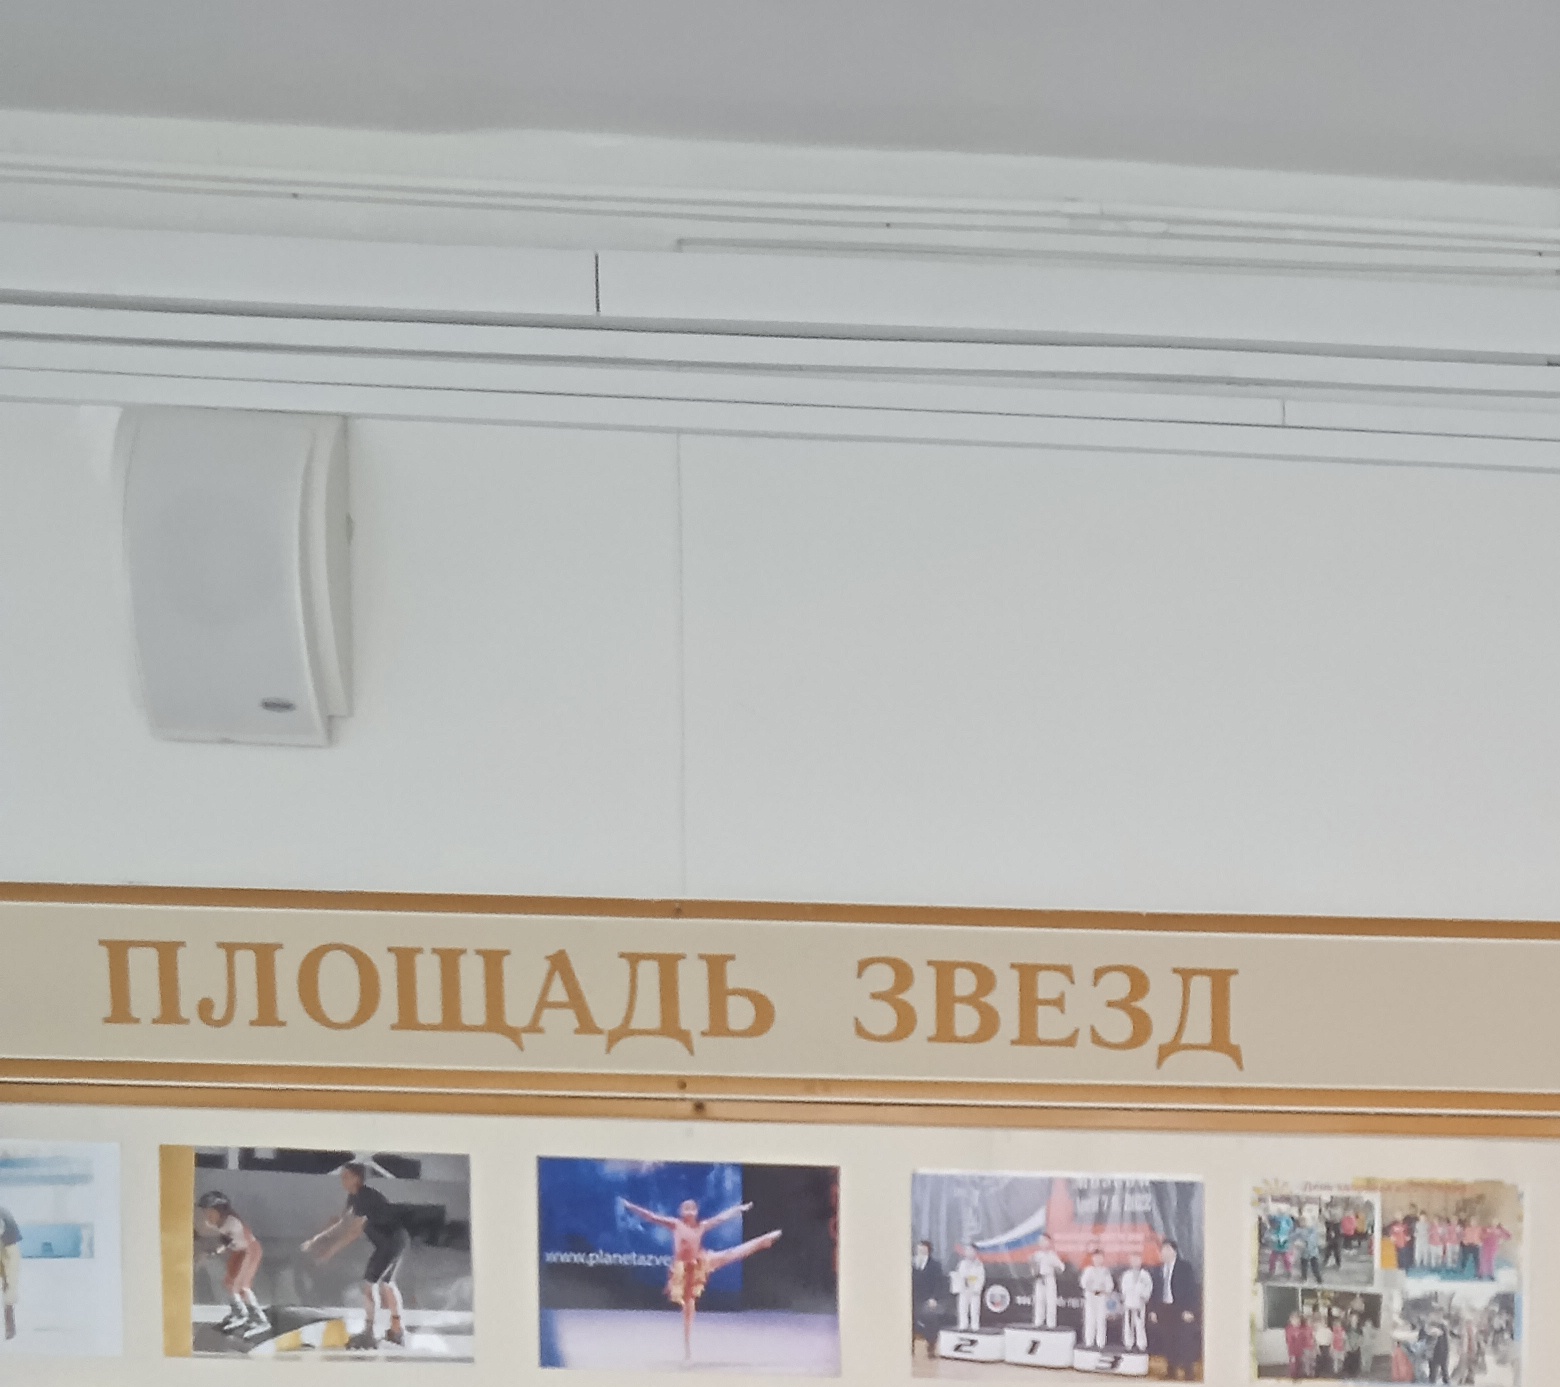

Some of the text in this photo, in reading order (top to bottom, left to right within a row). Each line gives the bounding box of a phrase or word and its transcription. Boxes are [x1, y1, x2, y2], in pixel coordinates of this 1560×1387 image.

[98, 938, 1245, 1072] ПЛОЩАДЬ ЗВЕЗД
[544, 1248, 672, 1267] www.planetazve
